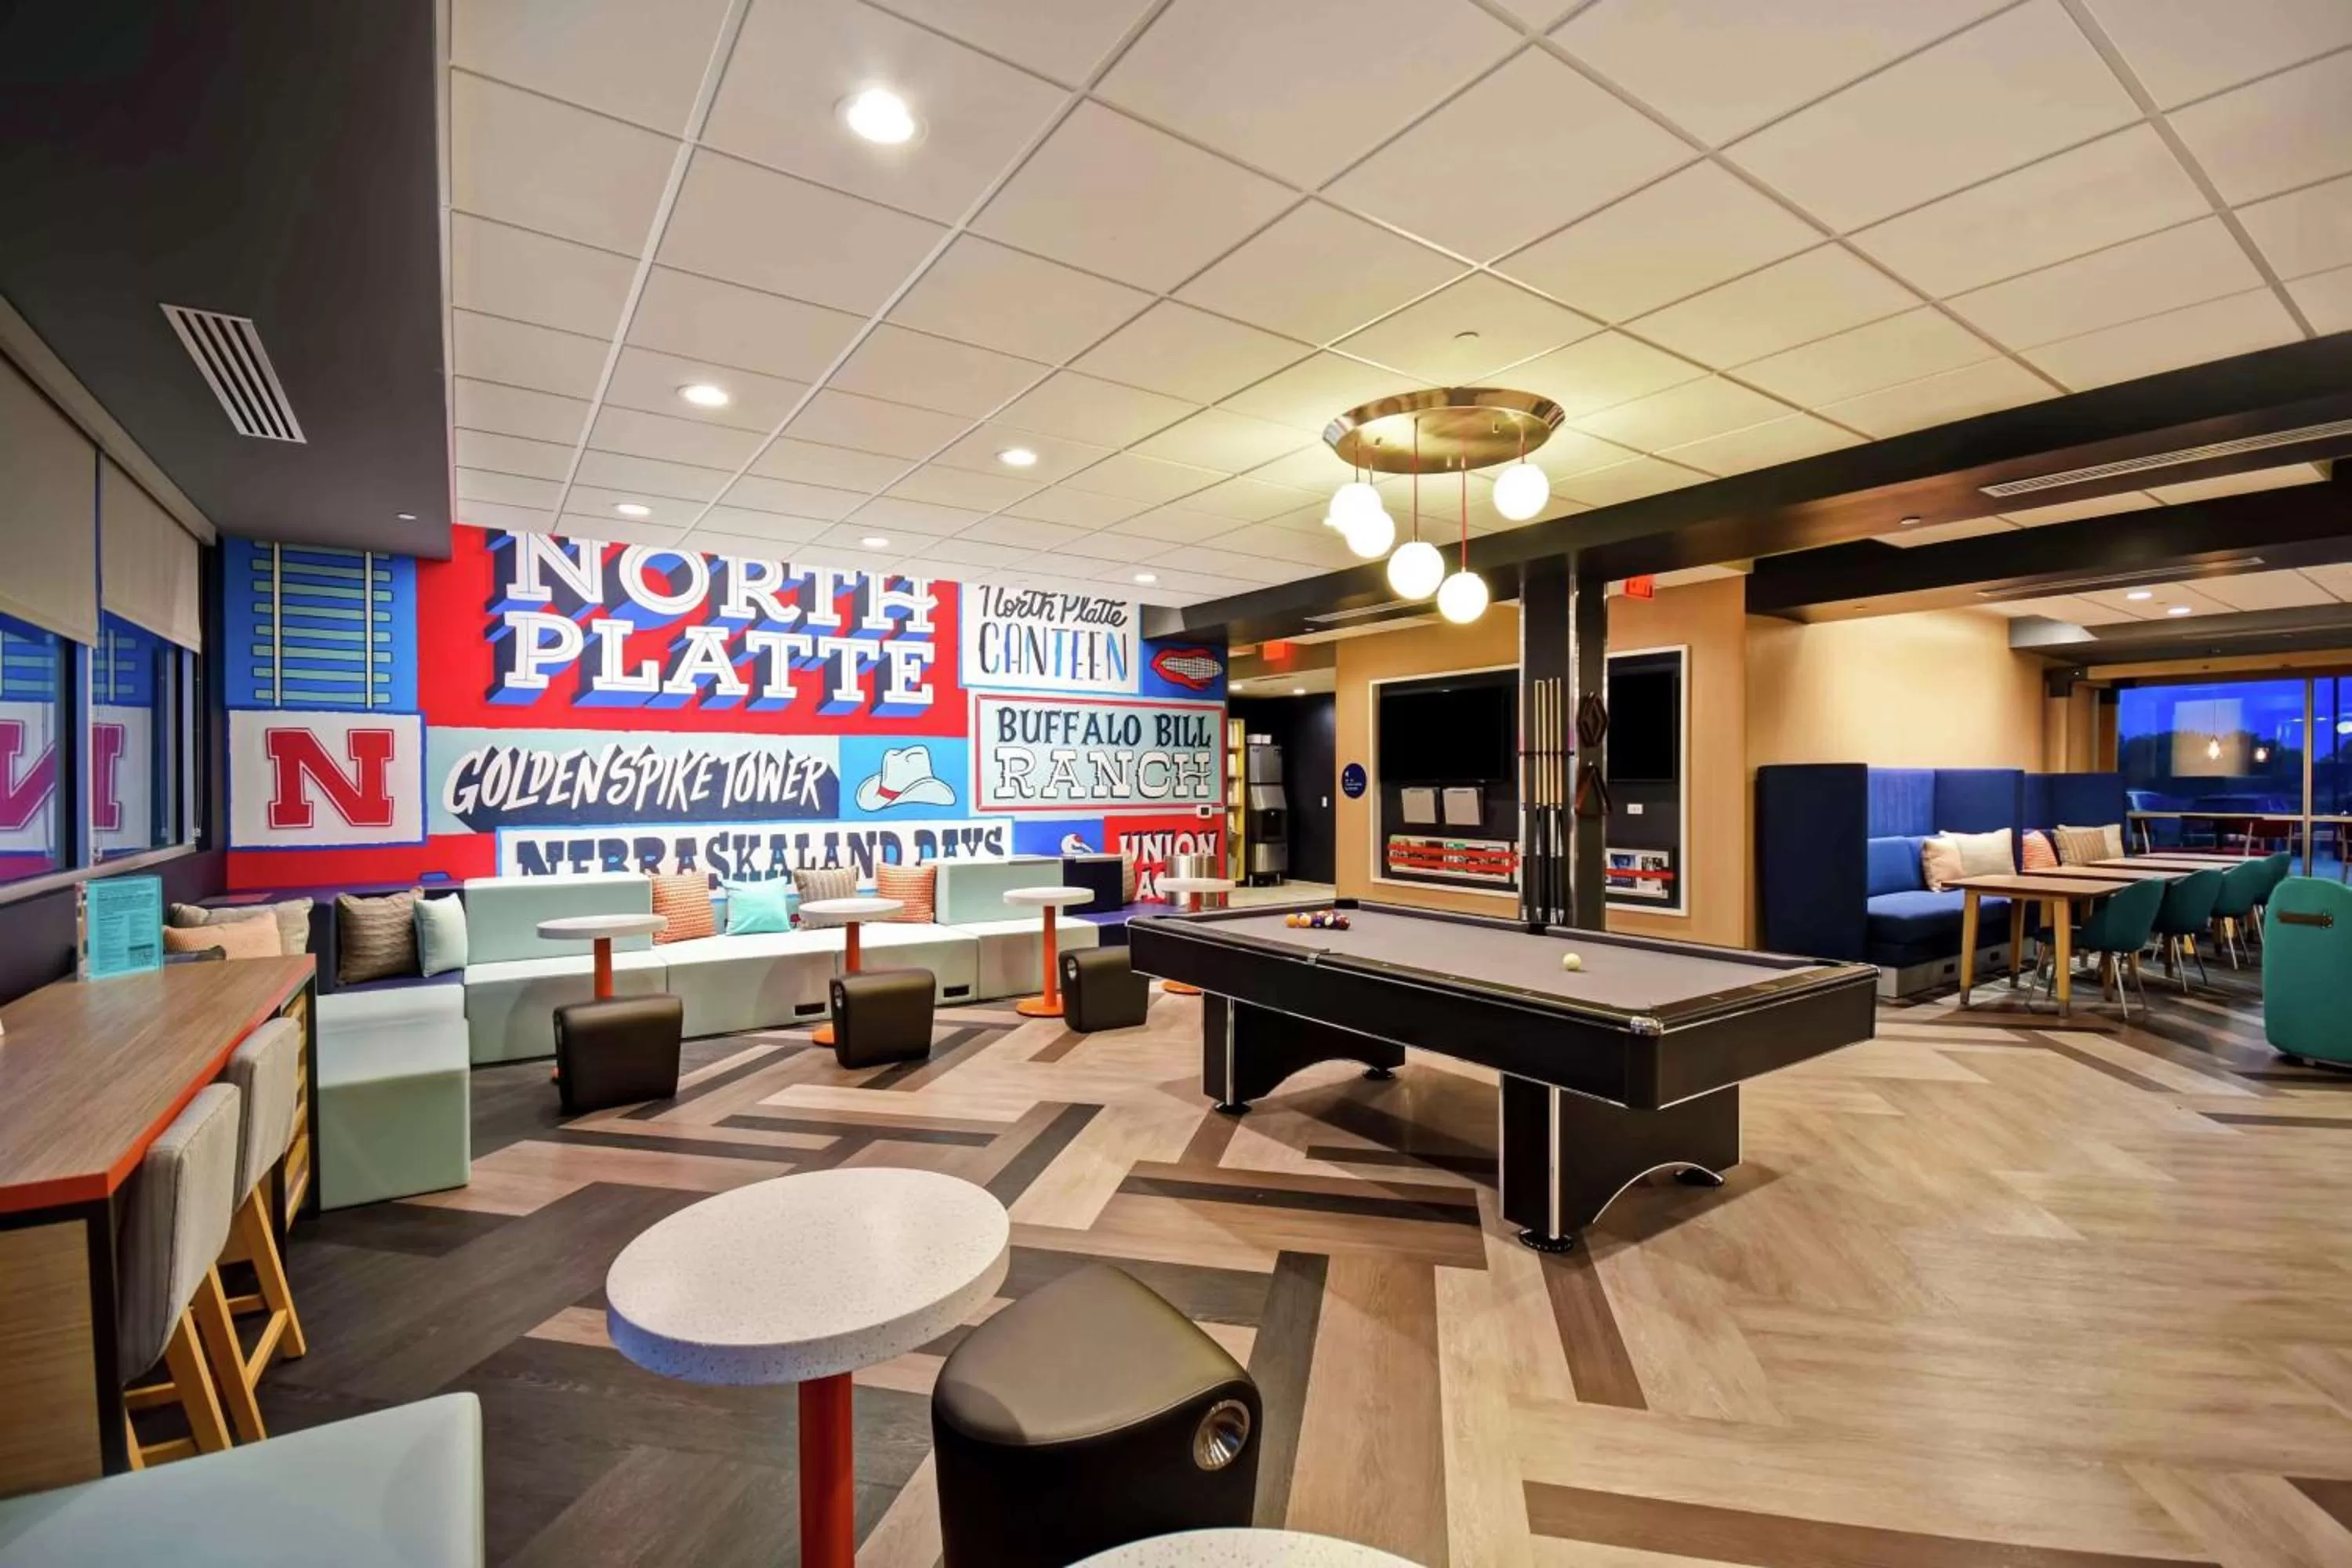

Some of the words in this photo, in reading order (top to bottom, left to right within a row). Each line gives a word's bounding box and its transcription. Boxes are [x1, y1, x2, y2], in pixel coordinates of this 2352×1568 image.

[505, 530, 939, 633] NORTH
[978, 584, 1058, 622] North
[1060, 593, 1127, 627] Platte
[503, 611, 936, 705] PLATTE
[978, 622, 1127, 681] CANTEEN
[996, 706, 1142, 746] BUFFALO
[1154, 712, 1212, 748] BILL
[266, 727, 394, 829] N
[442, 743, 616, 815] GOLDEN
[606, 743, 715, 813] SPIKE
[719, 748, 827, 811] TOWER
[993, 746, 1212, 799] RANCH
[517, 830, 902, 891] NEBRASKALAND
[915, 826, 1005, 866] DAYS
[1119, 829, 1218, 865] UNION
